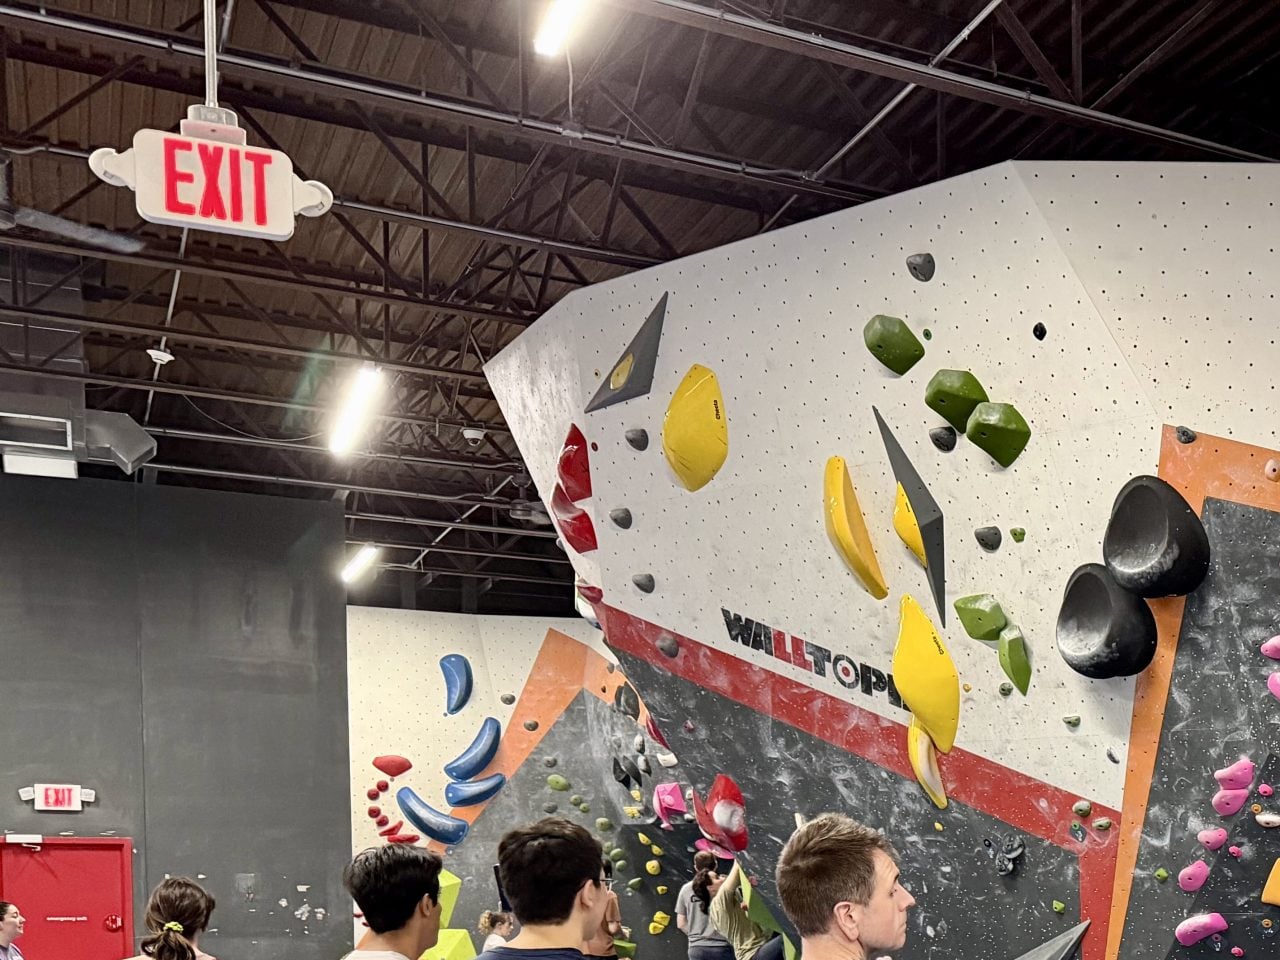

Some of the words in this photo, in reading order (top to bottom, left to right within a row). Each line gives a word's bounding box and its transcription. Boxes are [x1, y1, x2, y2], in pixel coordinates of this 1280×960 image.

[163, 138, 272, 226] EXIT
[721, 607, 912, 713] WALLTOPI
[44, 787, 73, 807] EXIT
